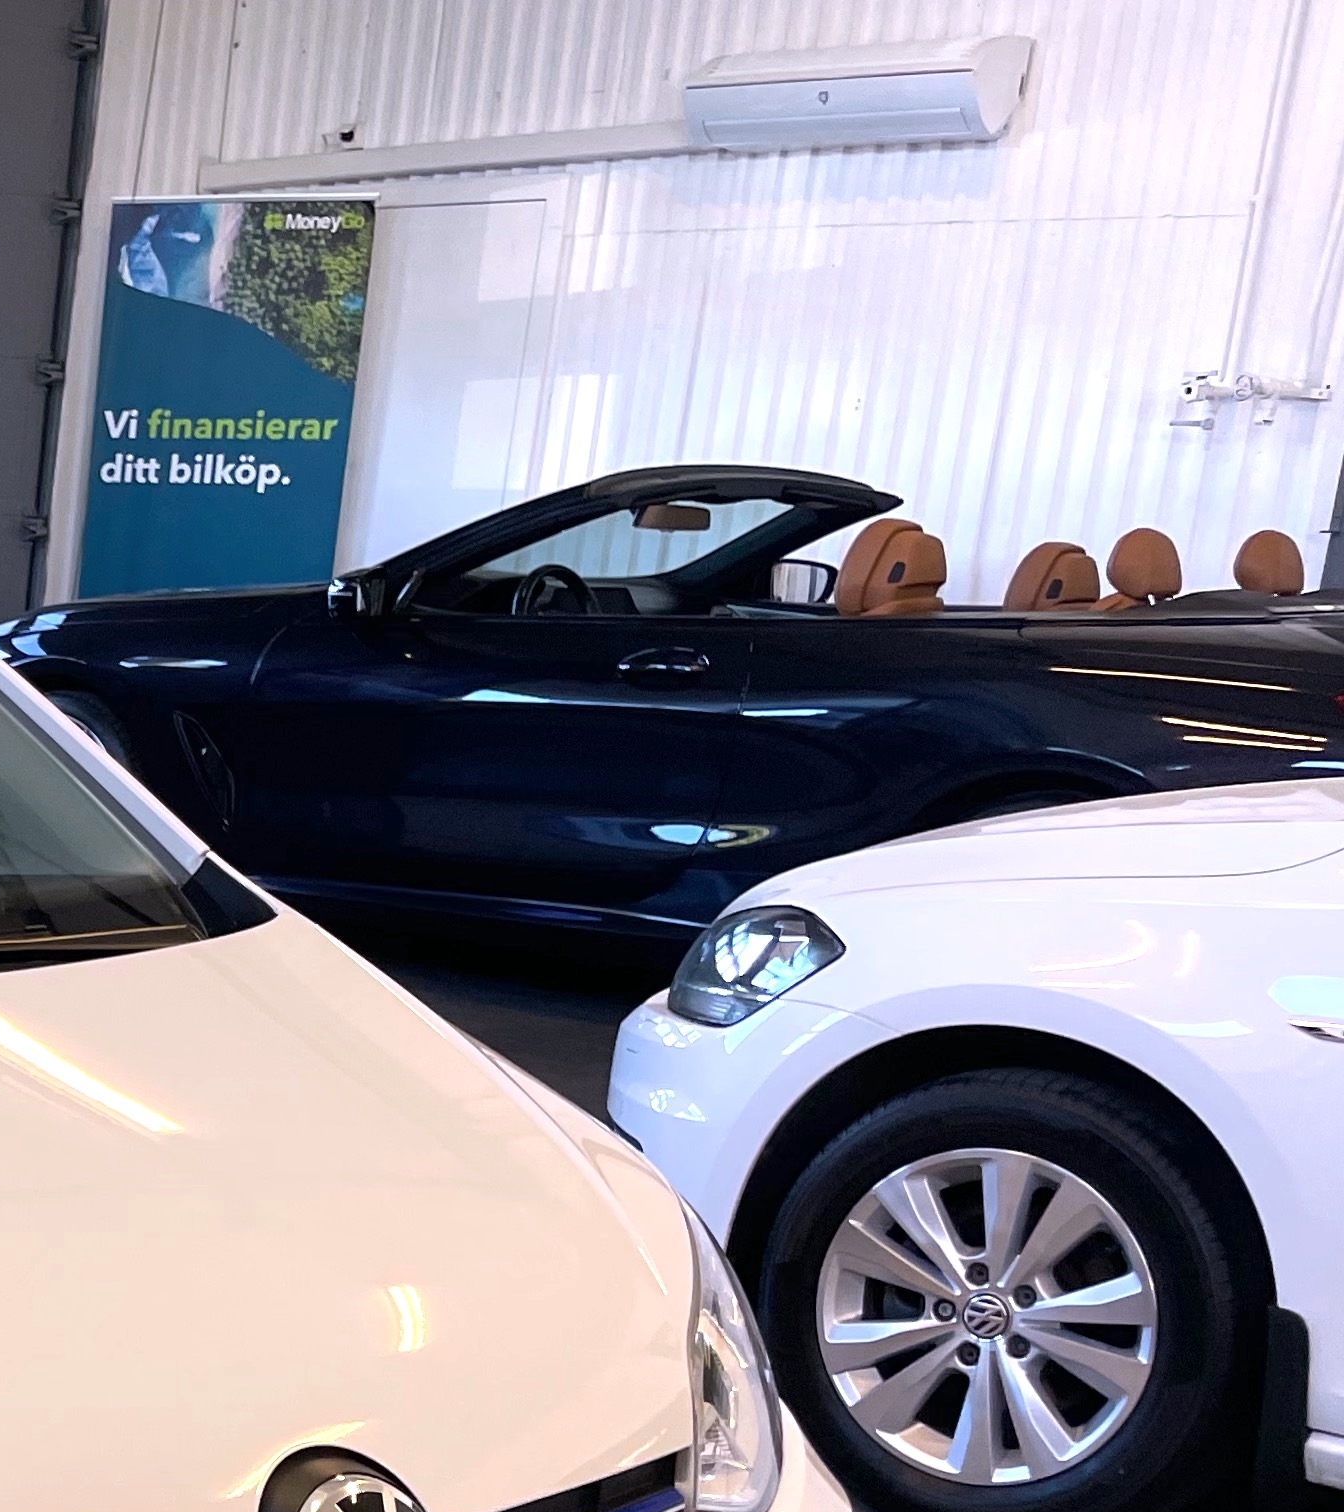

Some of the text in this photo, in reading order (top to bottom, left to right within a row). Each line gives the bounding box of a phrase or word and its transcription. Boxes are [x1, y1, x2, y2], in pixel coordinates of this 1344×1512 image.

[104, 408, 339, 440] Vi finansierar
[100, 453, 291, 494] ditt bilköp.
